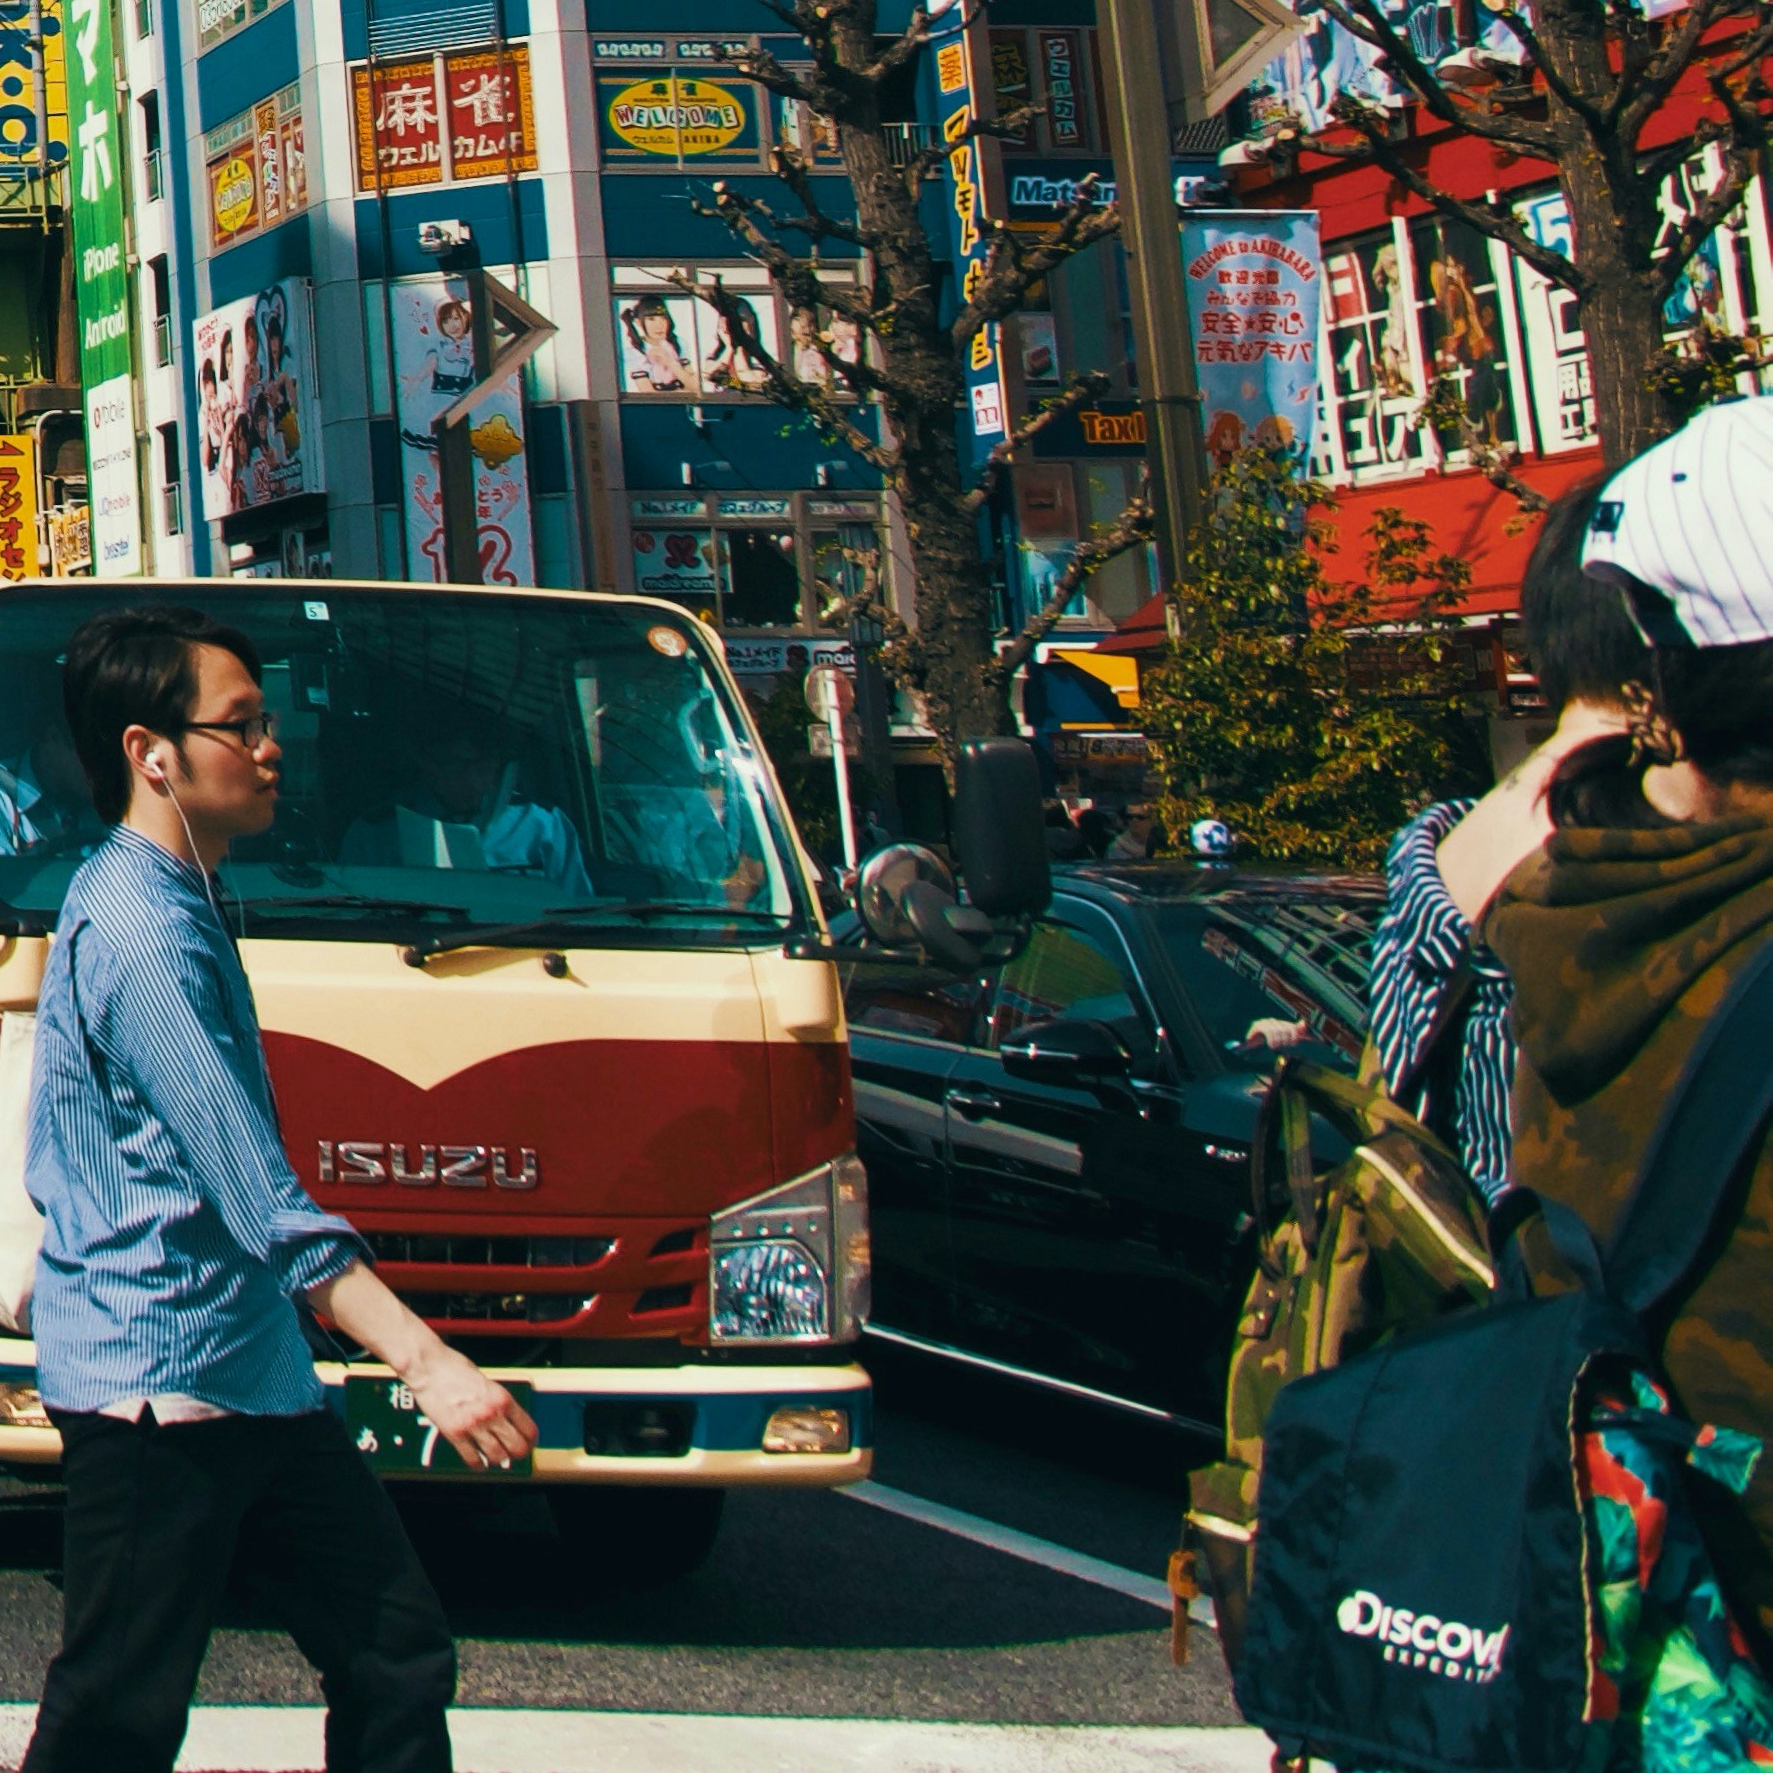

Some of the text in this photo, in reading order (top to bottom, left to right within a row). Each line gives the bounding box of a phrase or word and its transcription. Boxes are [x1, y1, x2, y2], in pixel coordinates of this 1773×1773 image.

[376, 73, 515, 137] 麻雀
[615, 105, 739, 129] WELCOME
[1188, 240, 1236, 280] WELCOME
[1251, 239, 1316, 282] AKIHABARA
[317, 1138, 539, 1190] ISUZU
